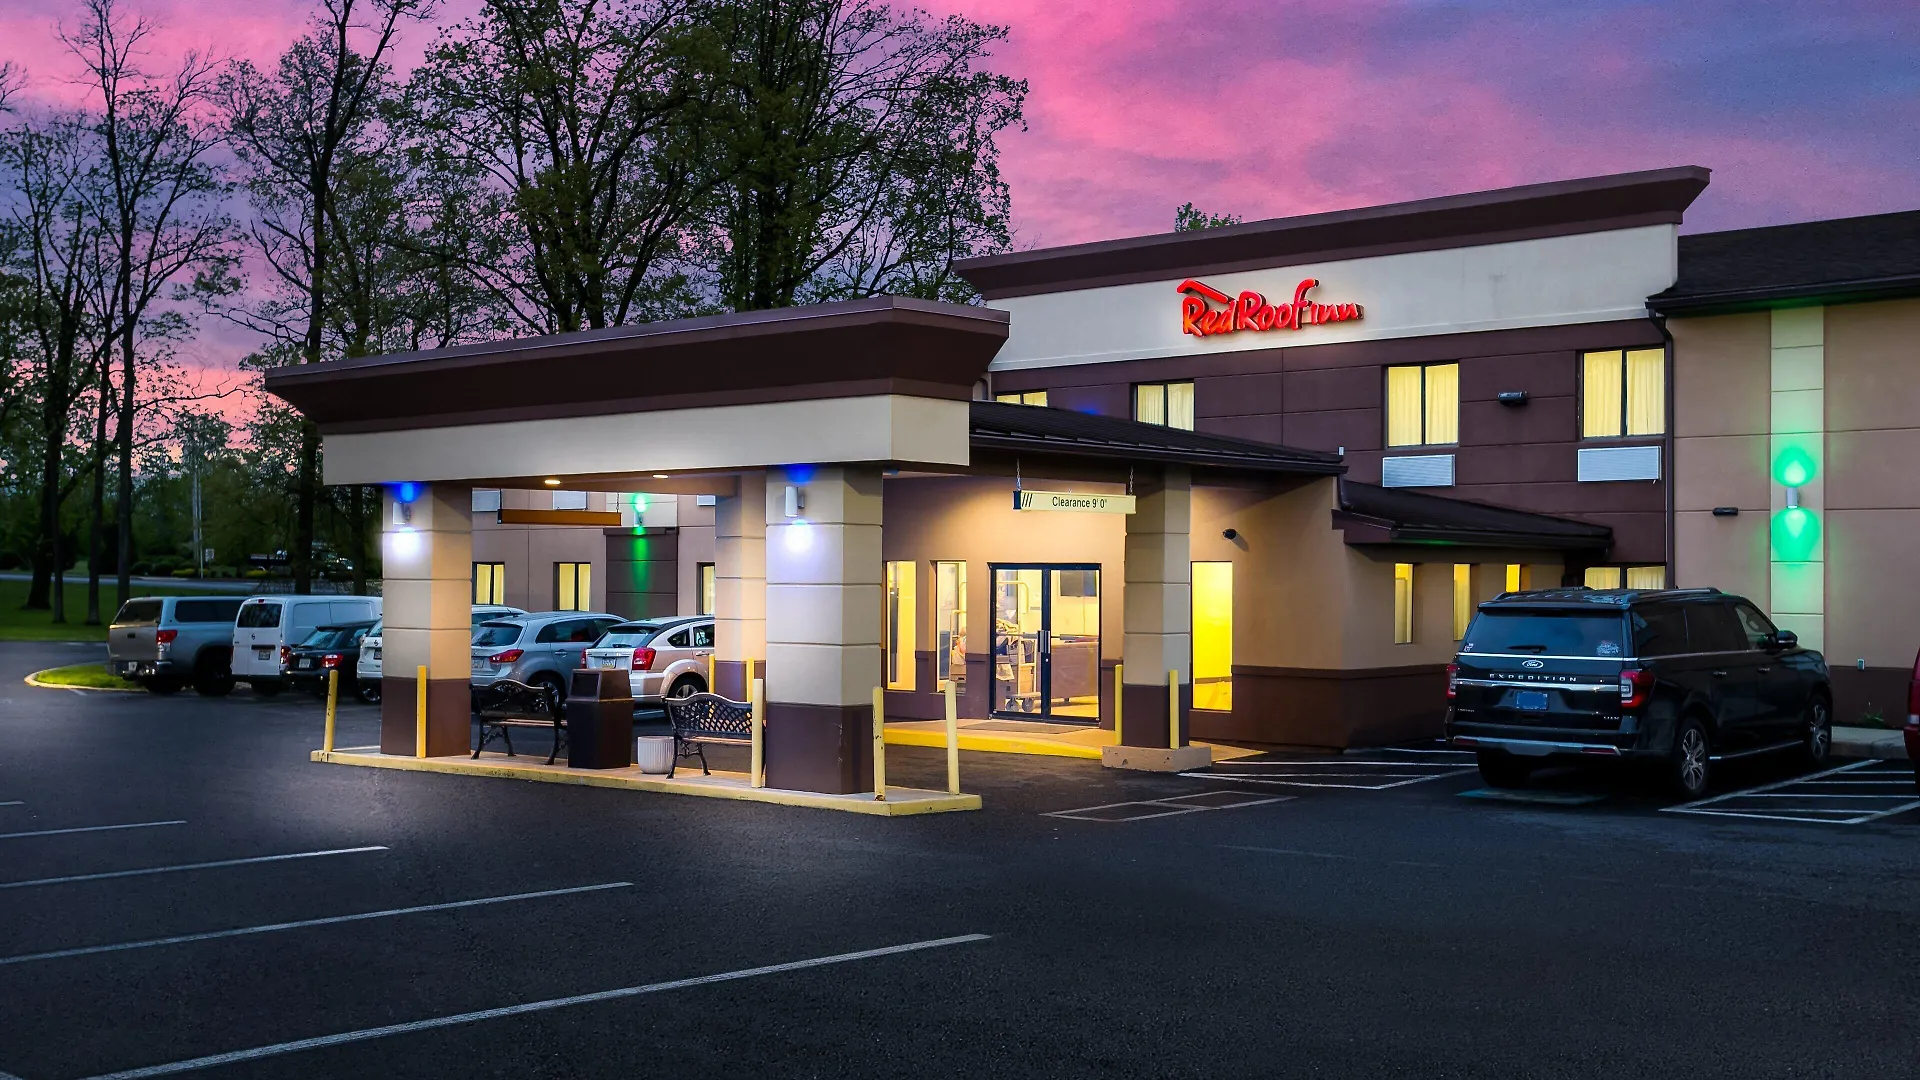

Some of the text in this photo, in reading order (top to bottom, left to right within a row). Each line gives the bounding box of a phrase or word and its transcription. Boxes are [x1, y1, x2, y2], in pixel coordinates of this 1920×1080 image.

[1182, 296, 1237, 337] Red
[1236, 278, 1319, 331] Roof
[1052, 496, 1091, 508] Clearance
[1489, 673, 1577, 682] EXPEDITION
